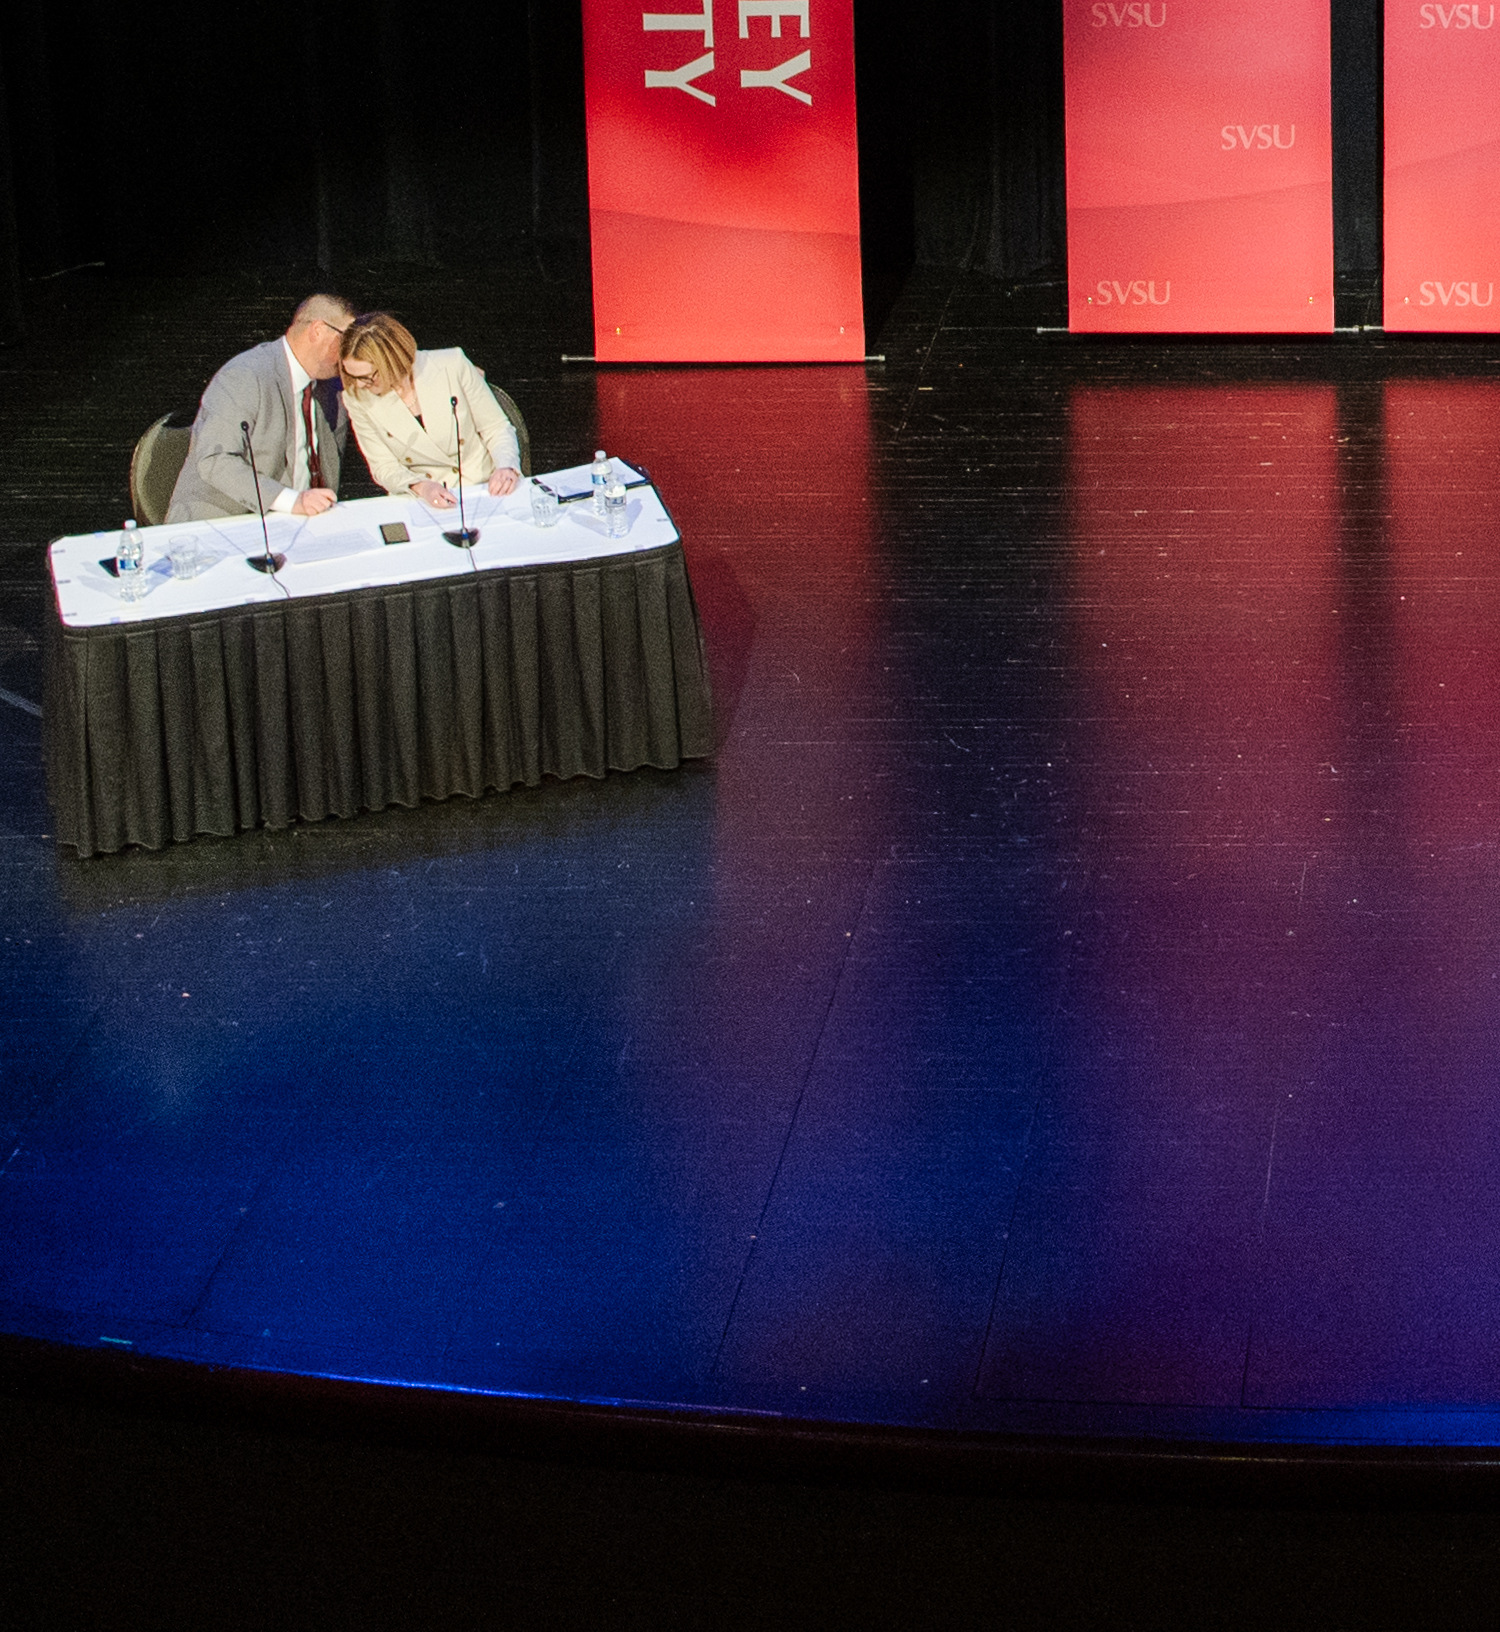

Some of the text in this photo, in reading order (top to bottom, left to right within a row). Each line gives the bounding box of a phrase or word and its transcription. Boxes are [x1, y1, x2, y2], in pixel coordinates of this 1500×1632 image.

[1091, 1, 1167, 29] SVSU
[1419, 2, 1496, 30] SVSU
[1220, 124, 1296, 151] SVSU
[1097, 280, 1172, 306] SVSU
[1419, 280, 1494, 307] SVSU
